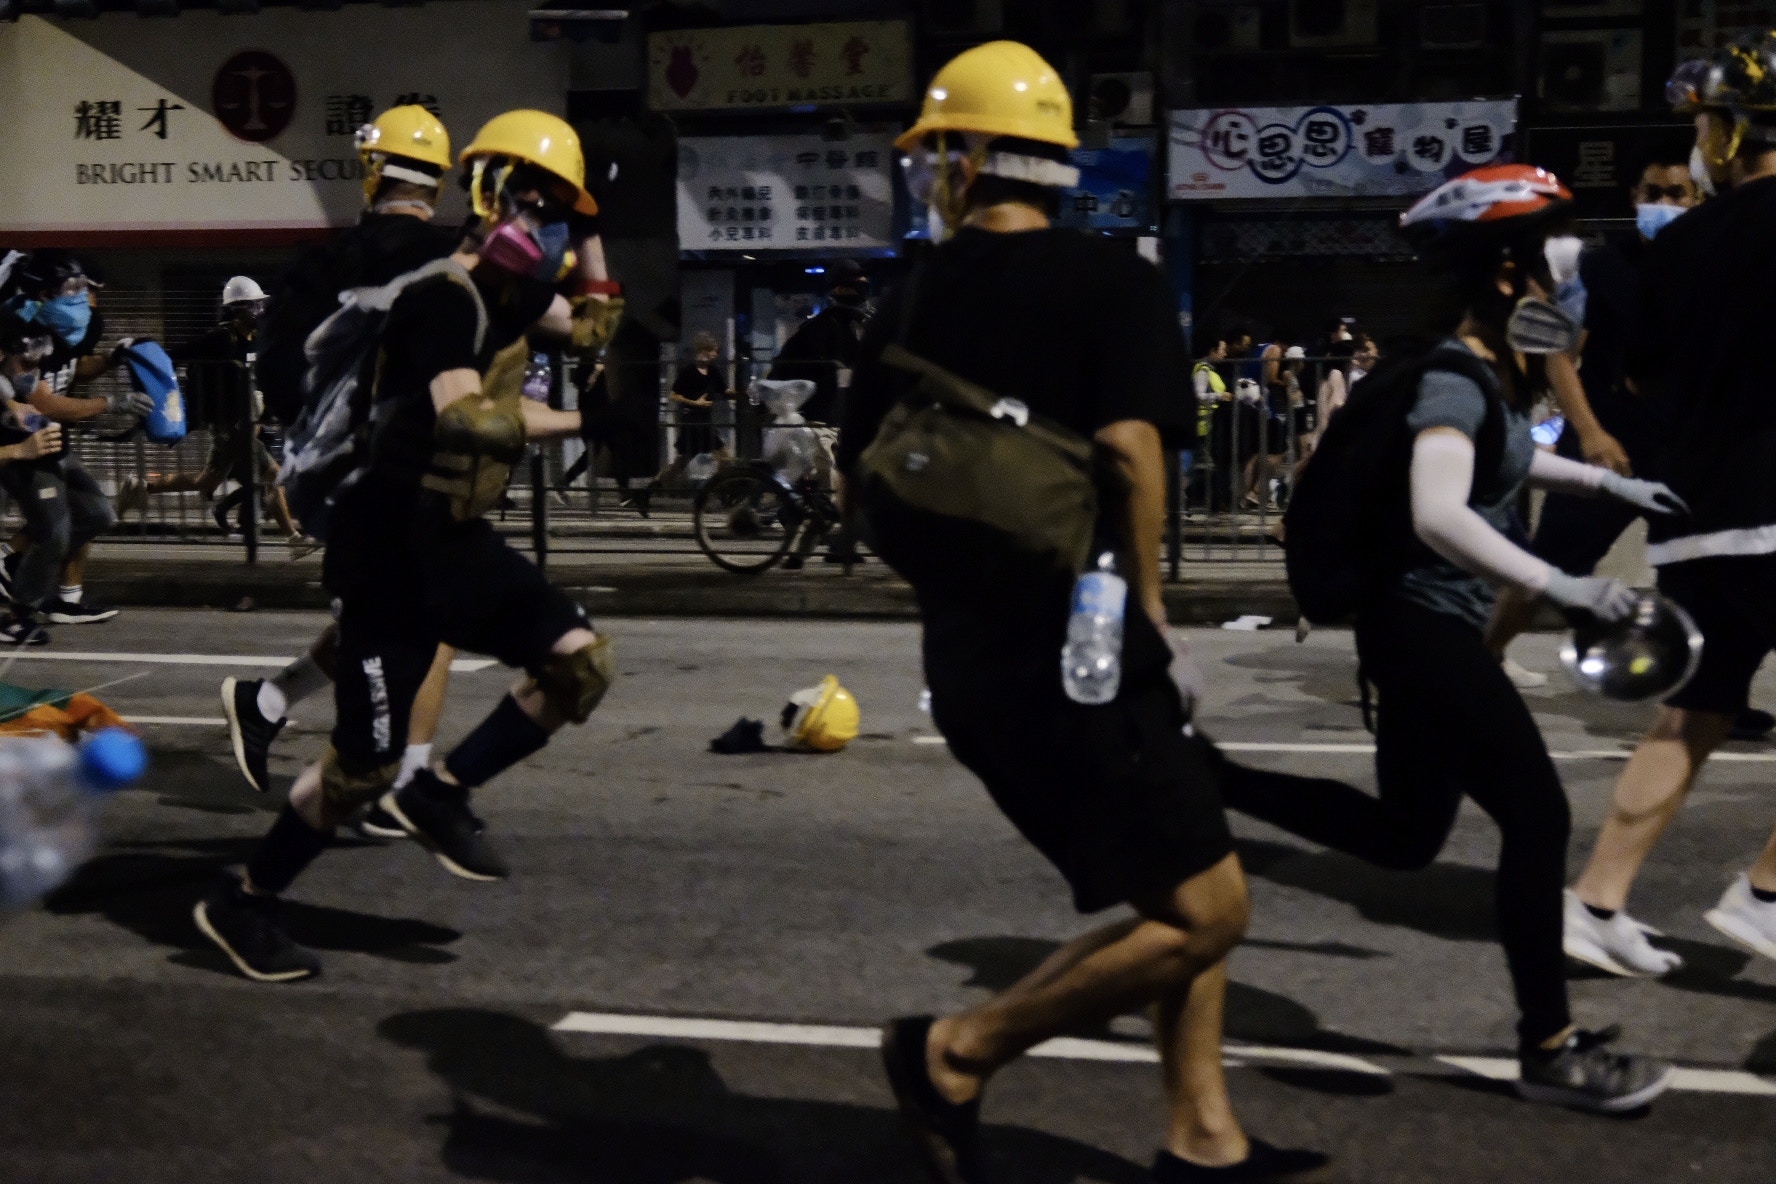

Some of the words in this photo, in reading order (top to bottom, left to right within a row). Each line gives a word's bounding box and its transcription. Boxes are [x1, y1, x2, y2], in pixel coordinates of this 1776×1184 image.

[727, 87, 780, 103] FOOT
[787, 83, 891, 101] MASSAGE
[74, 98, 186, 141] 耀才
[76, 162, 177, 185] BRIGHT
[188, 161, 279, 183] SMART
[289, 159, 366, 182] SECU
